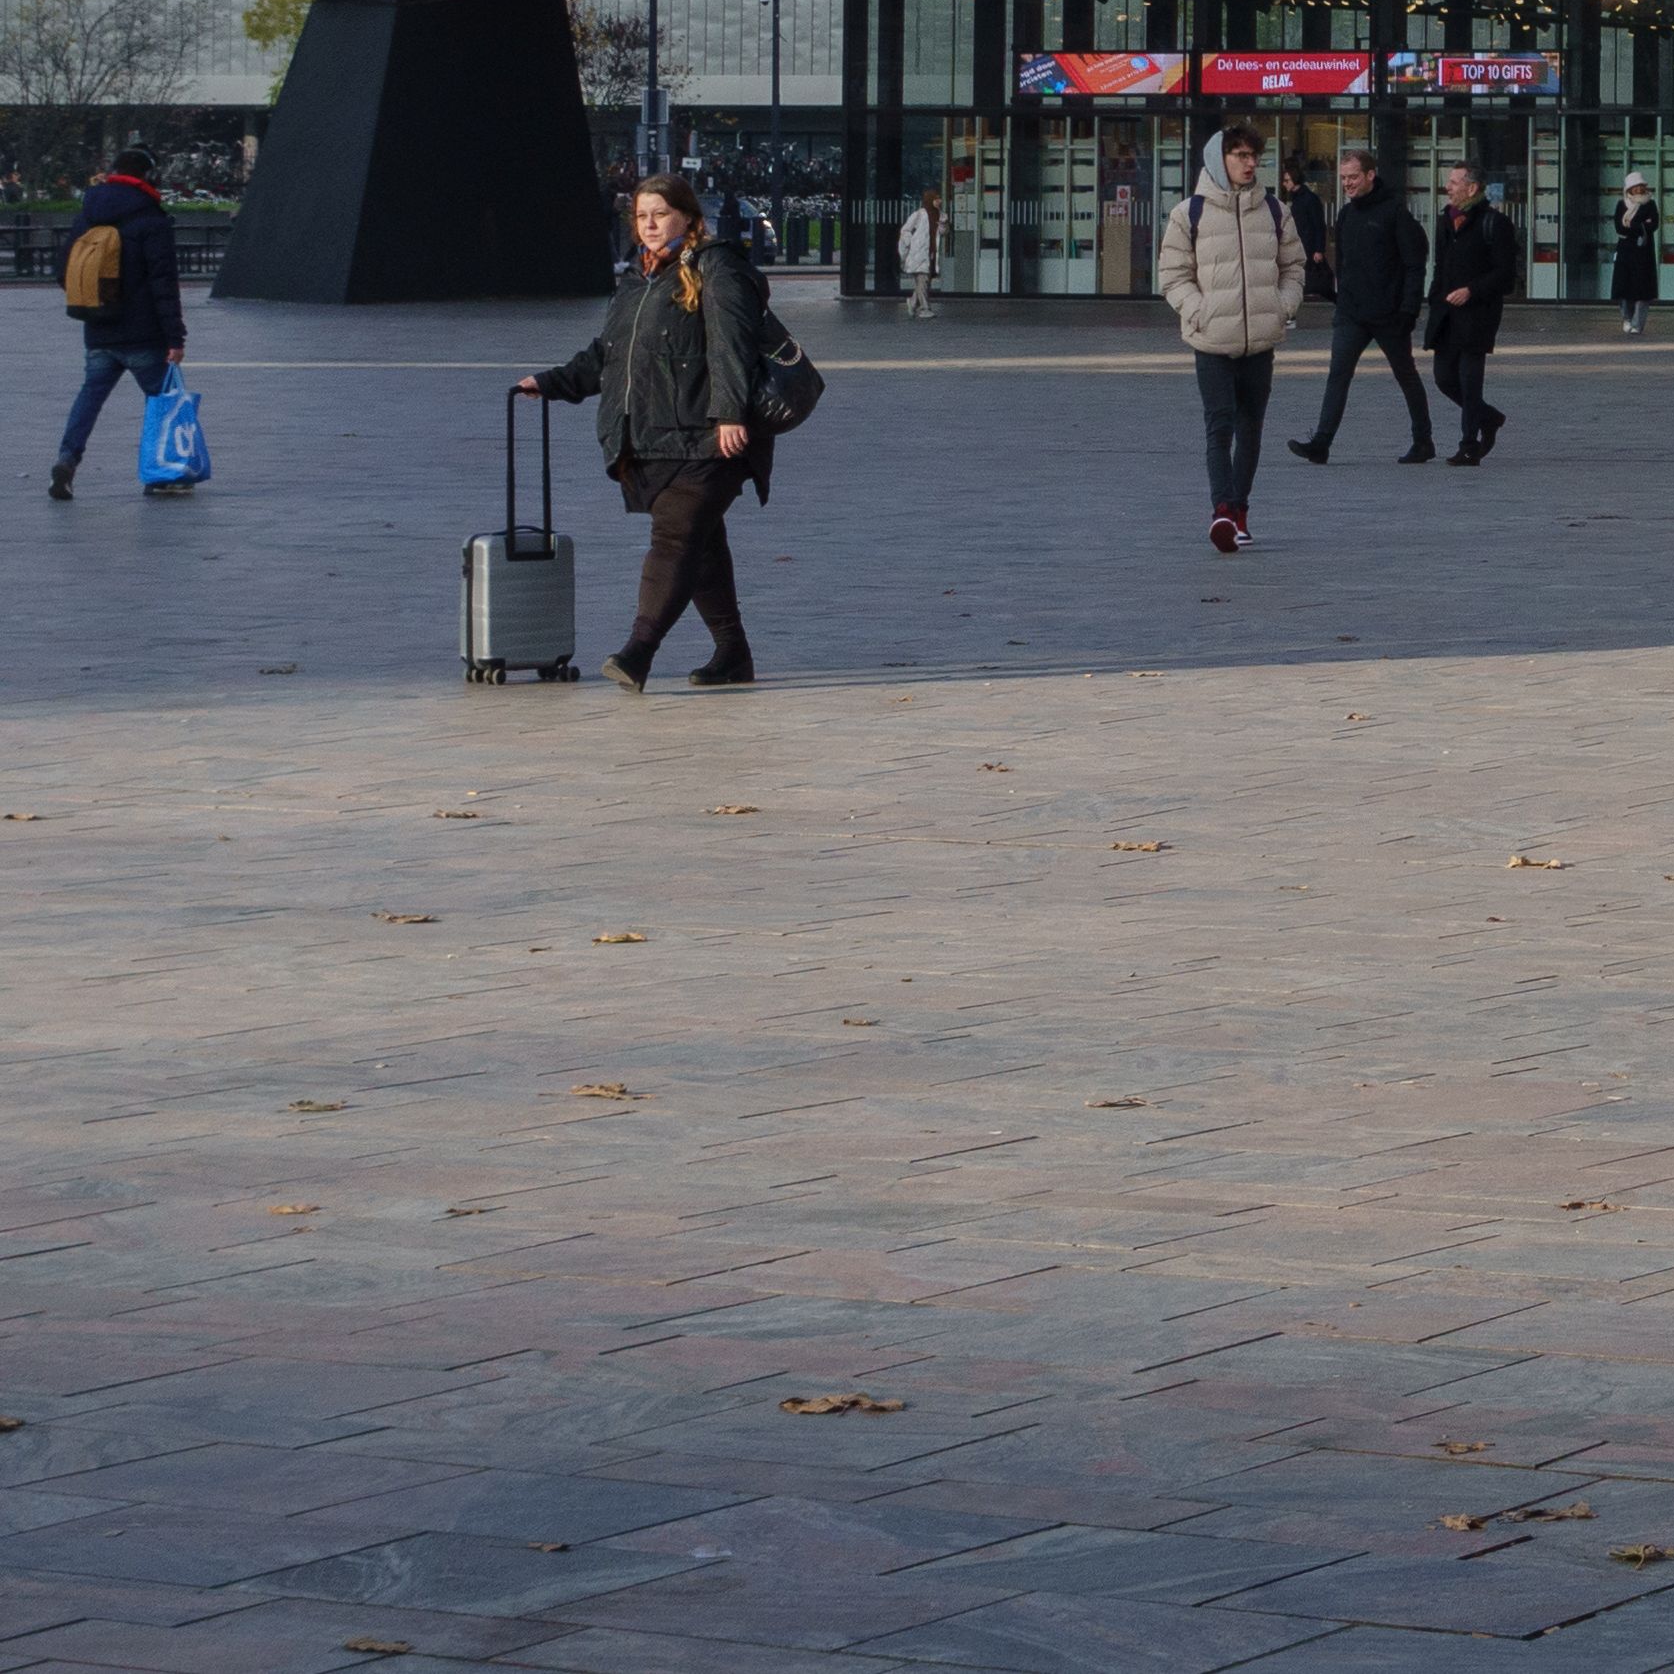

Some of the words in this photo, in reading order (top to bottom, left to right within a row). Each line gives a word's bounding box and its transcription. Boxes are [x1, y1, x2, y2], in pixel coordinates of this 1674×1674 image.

[1235, 58, 1263, 71] lees-
[1266, 61, 1280, 71] en
[1282, 58, 1360, 71] cadeauwinkel
[1461, 64, 1485, 80] TOP
[1488, 64, 1500, 80] 10
[1502, 64, 1533, 80] GIFTS
